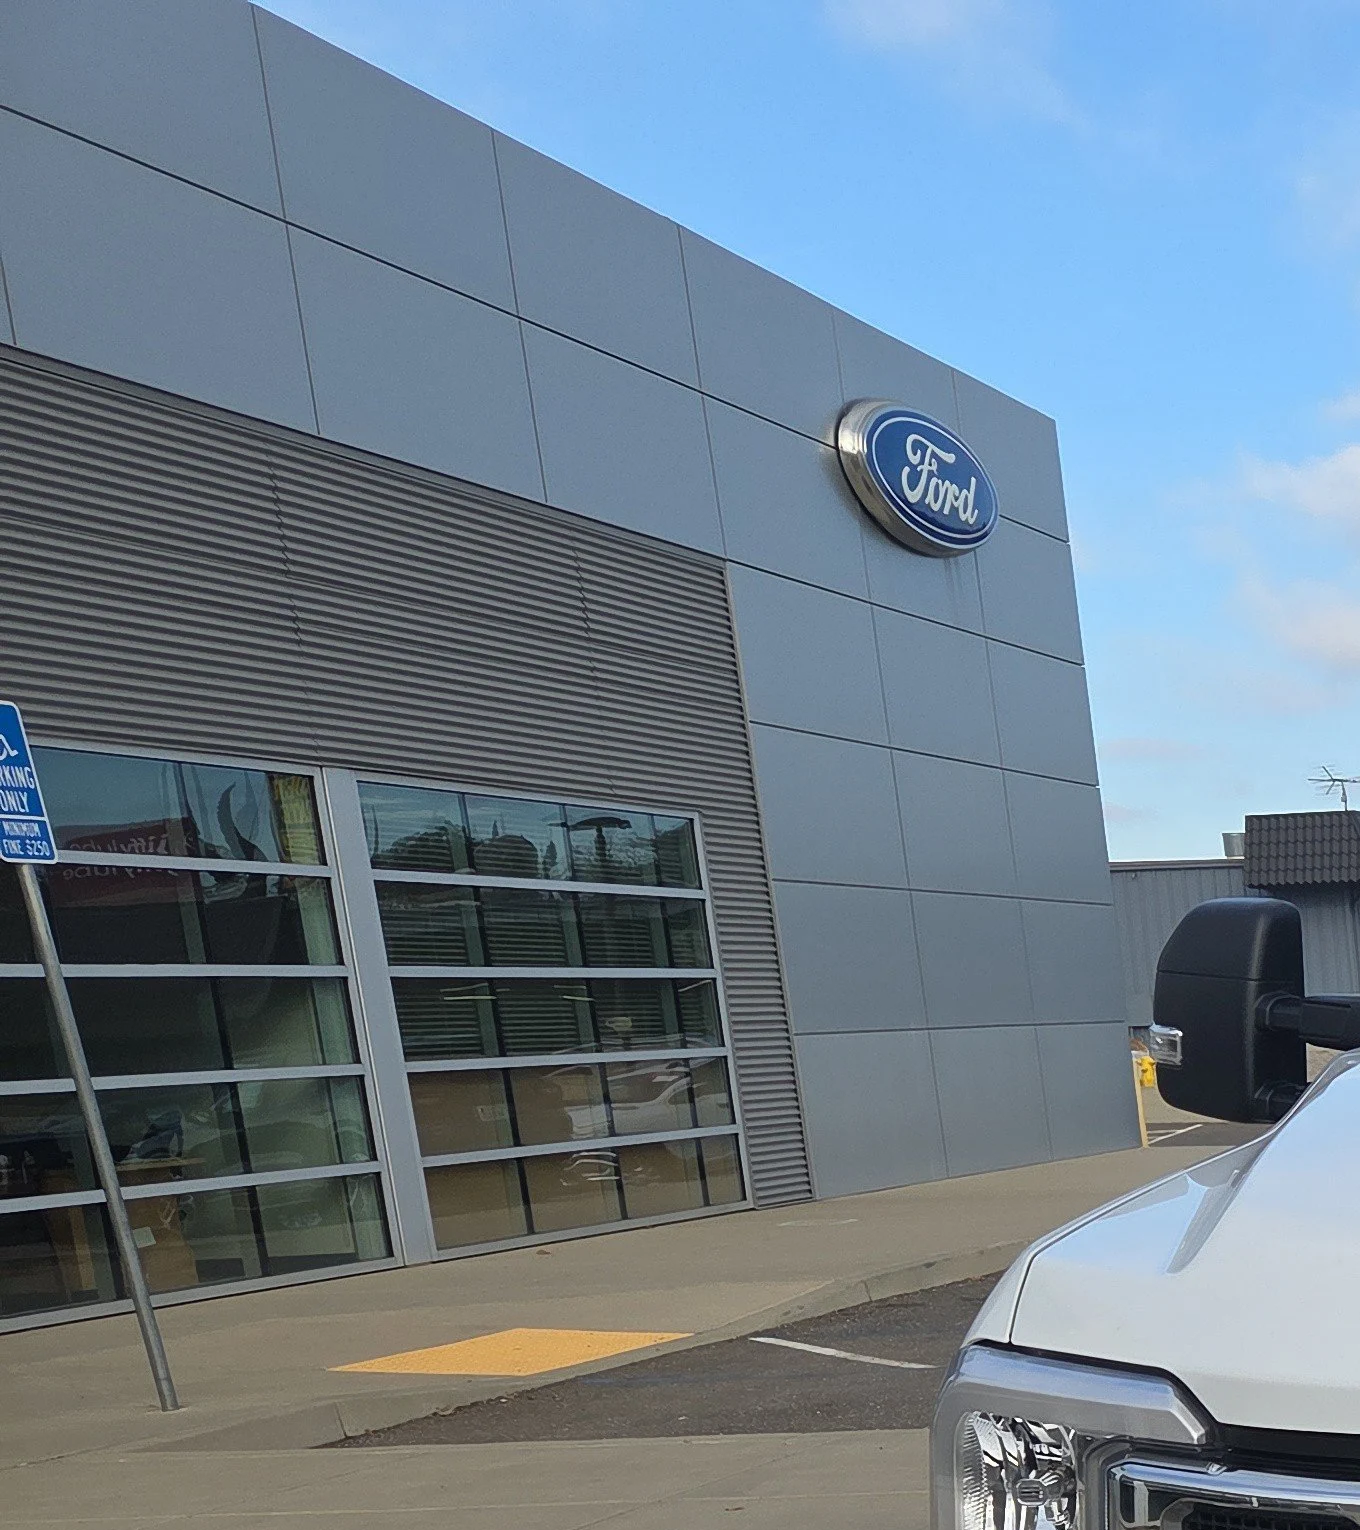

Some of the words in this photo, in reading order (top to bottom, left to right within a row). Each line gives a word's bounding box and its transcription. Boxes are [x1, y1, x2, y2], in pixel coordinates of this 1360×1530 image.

[902, 434, 979, 524] Ford
[0, 789, 29, 812] ONLY
[3, 839, 23, 854] FINE
[26, 840, 51, 856] $250
